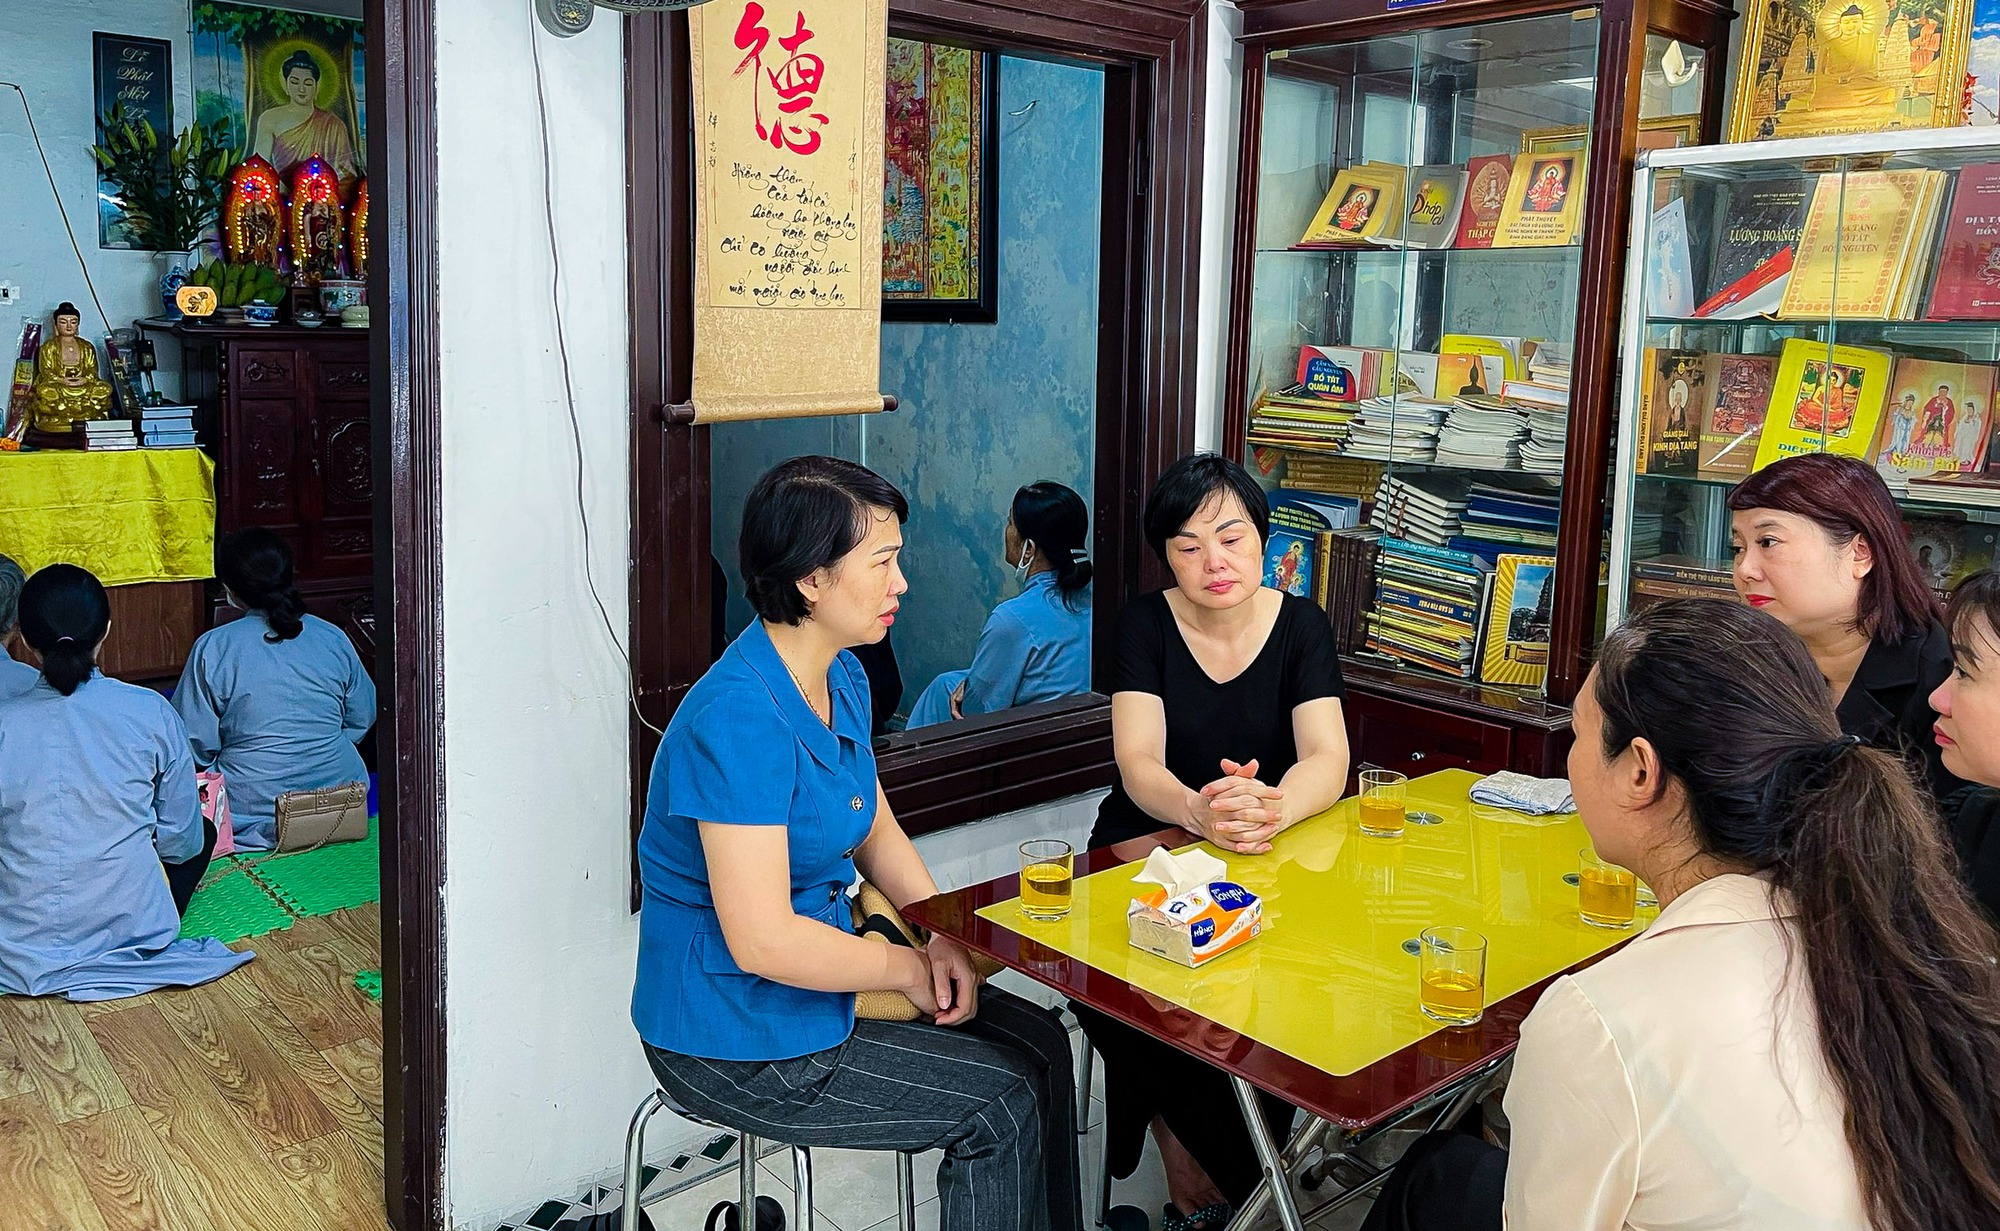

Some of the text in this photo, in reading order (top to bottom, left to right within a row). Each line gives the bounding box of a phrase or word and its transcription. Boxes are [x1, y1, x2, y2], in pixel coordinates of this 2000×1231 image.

[120, 47, 150, 62] Lễ
[116, 65, 153, 84] Phật
[730, 1, 829, 155] 德
[117, 85, 150, 102] Một
[1653, 441, 1698, 452] KINH ĐỊA TẠNG
